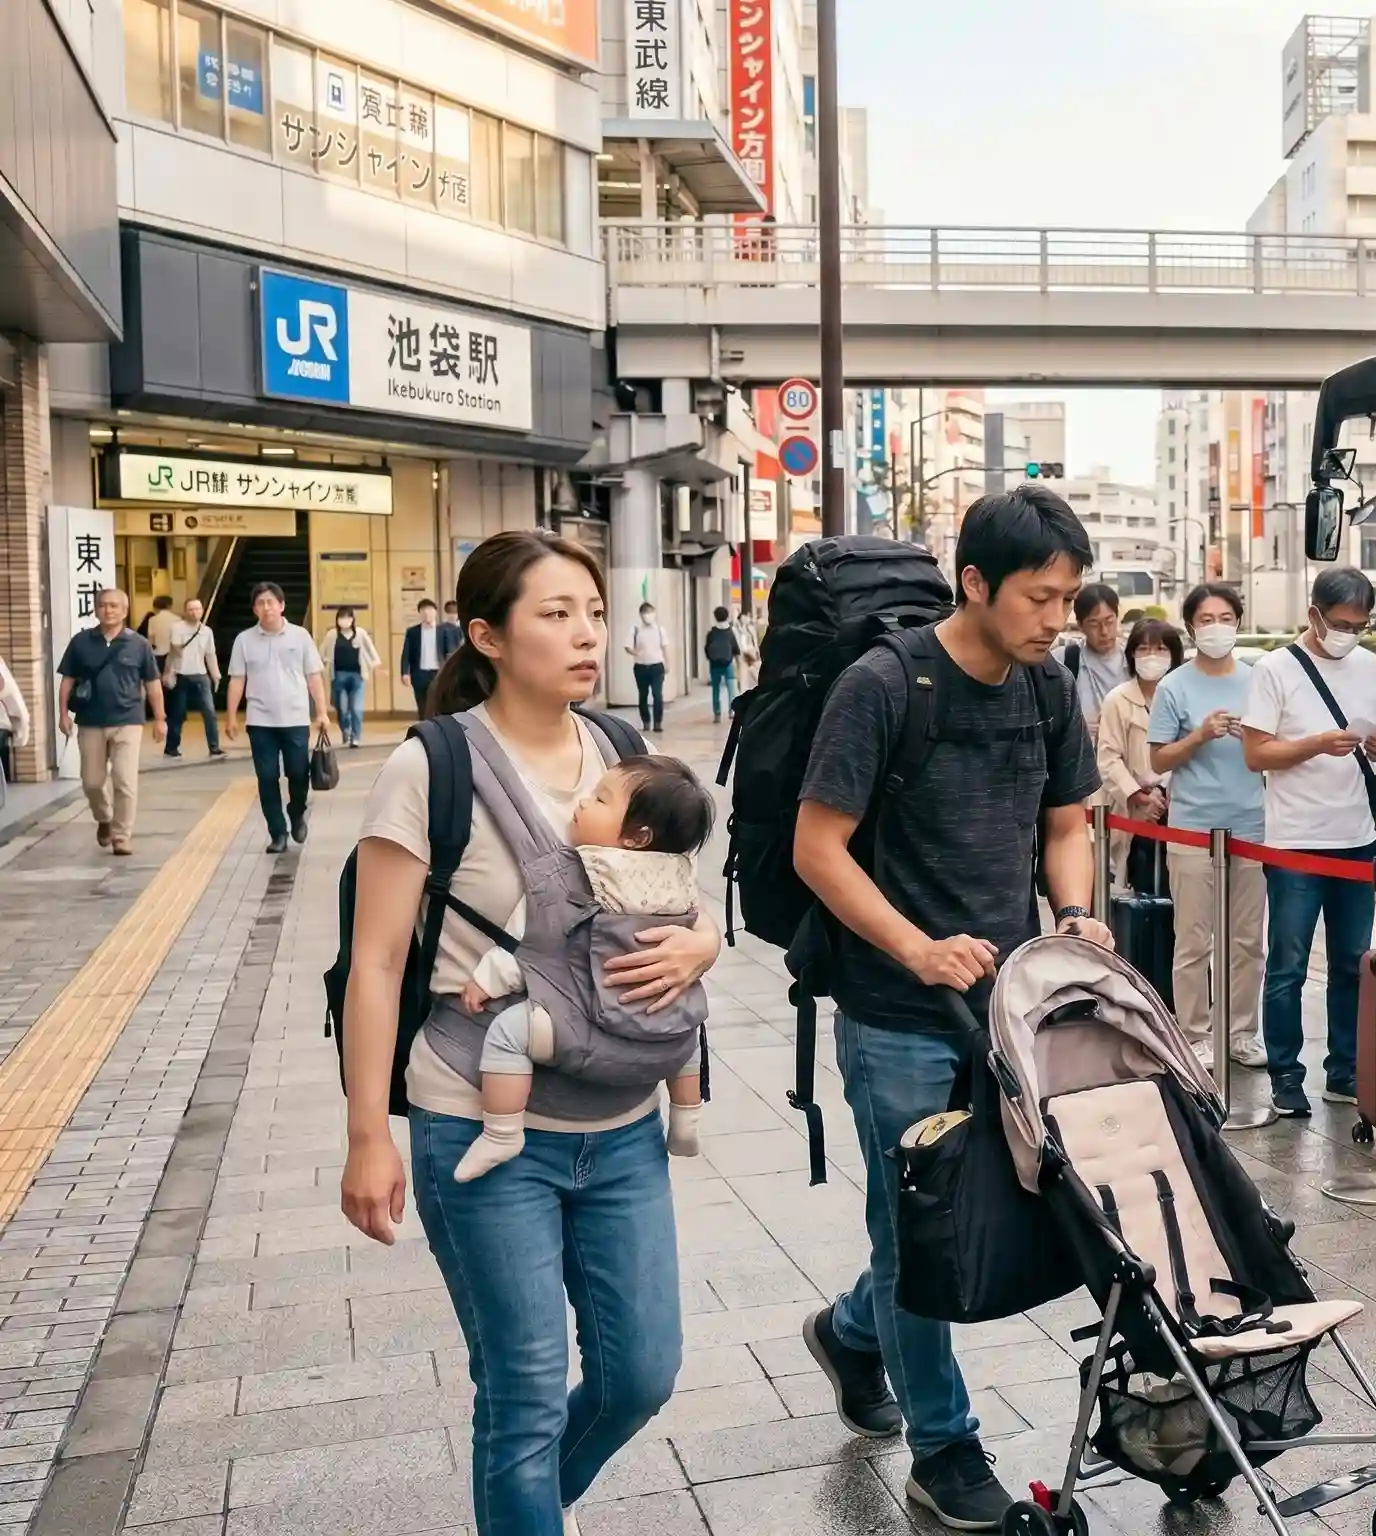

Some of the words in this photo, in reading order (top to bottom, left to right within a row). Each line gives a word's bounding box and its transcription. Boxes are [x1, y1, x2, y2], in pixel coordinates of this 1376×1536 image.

[634, 0, 670, 109] 東武線
[276, 300, 338, 361] JR
[387, 313, 500, 387] 池袋駅
[388, 378, 454, 405] Ikebukuro
[457, 390, 502, 412] Station
[786, 391, 810, 408] 80
[148, 466, 174, 489] JR
[76, 534, 102, 632] 東武
